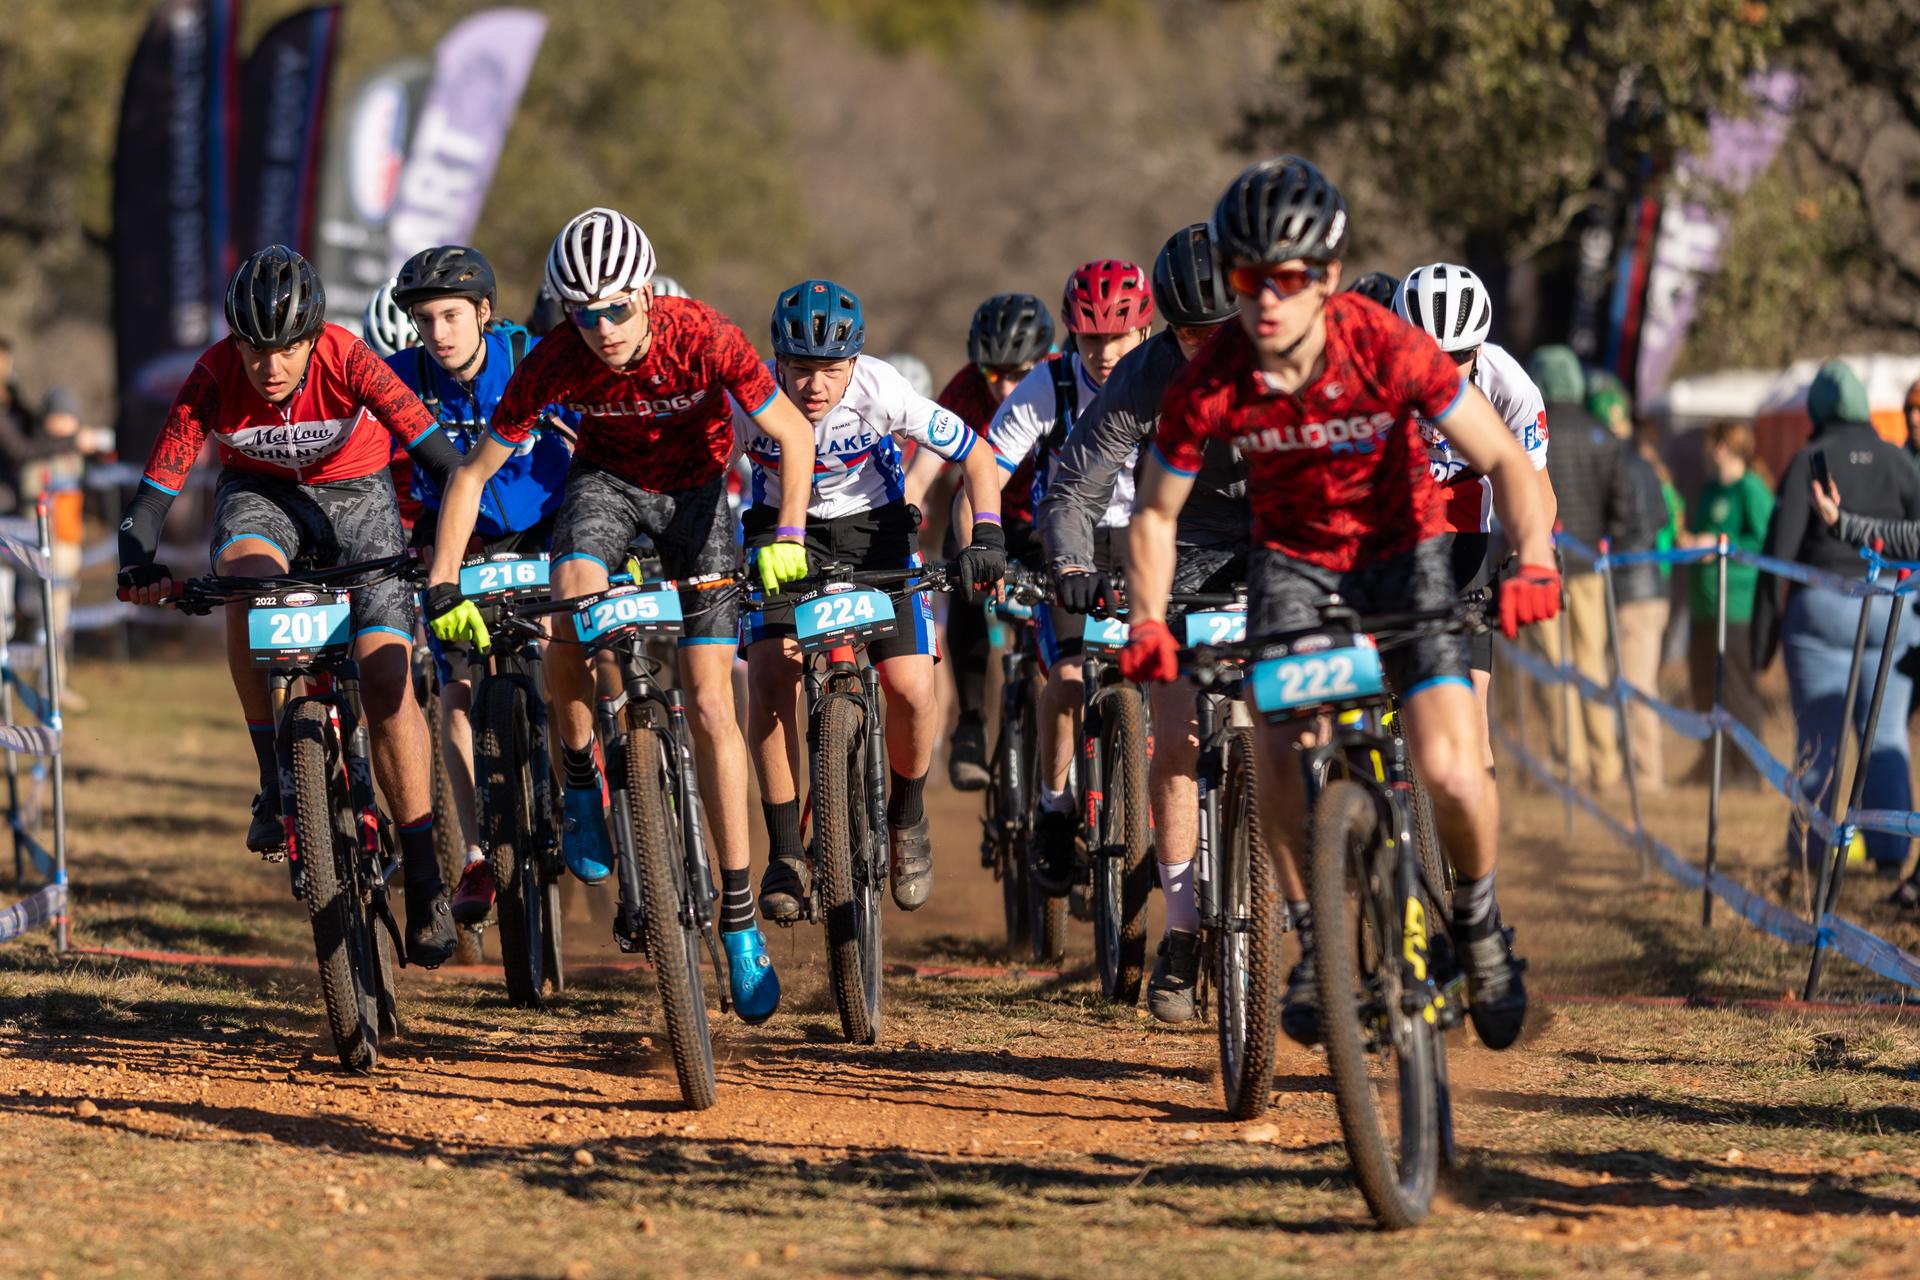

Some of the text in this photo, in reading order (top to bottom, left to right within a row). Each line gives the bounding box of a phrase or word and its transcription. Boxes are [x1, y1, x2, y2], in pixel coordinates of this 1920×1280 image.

[245, 428, 334, 446] Mellow
[479, 563, 536, 589] 216
[255, 596, 277, 606] 2022
[594, 595, 660, 631] 205
[814, 594, 875, 630] 224
[270, 610, 328, 645] 201
[1209, 615, 1247, 645] 22
[1277, 655, 1358, 703] 222
